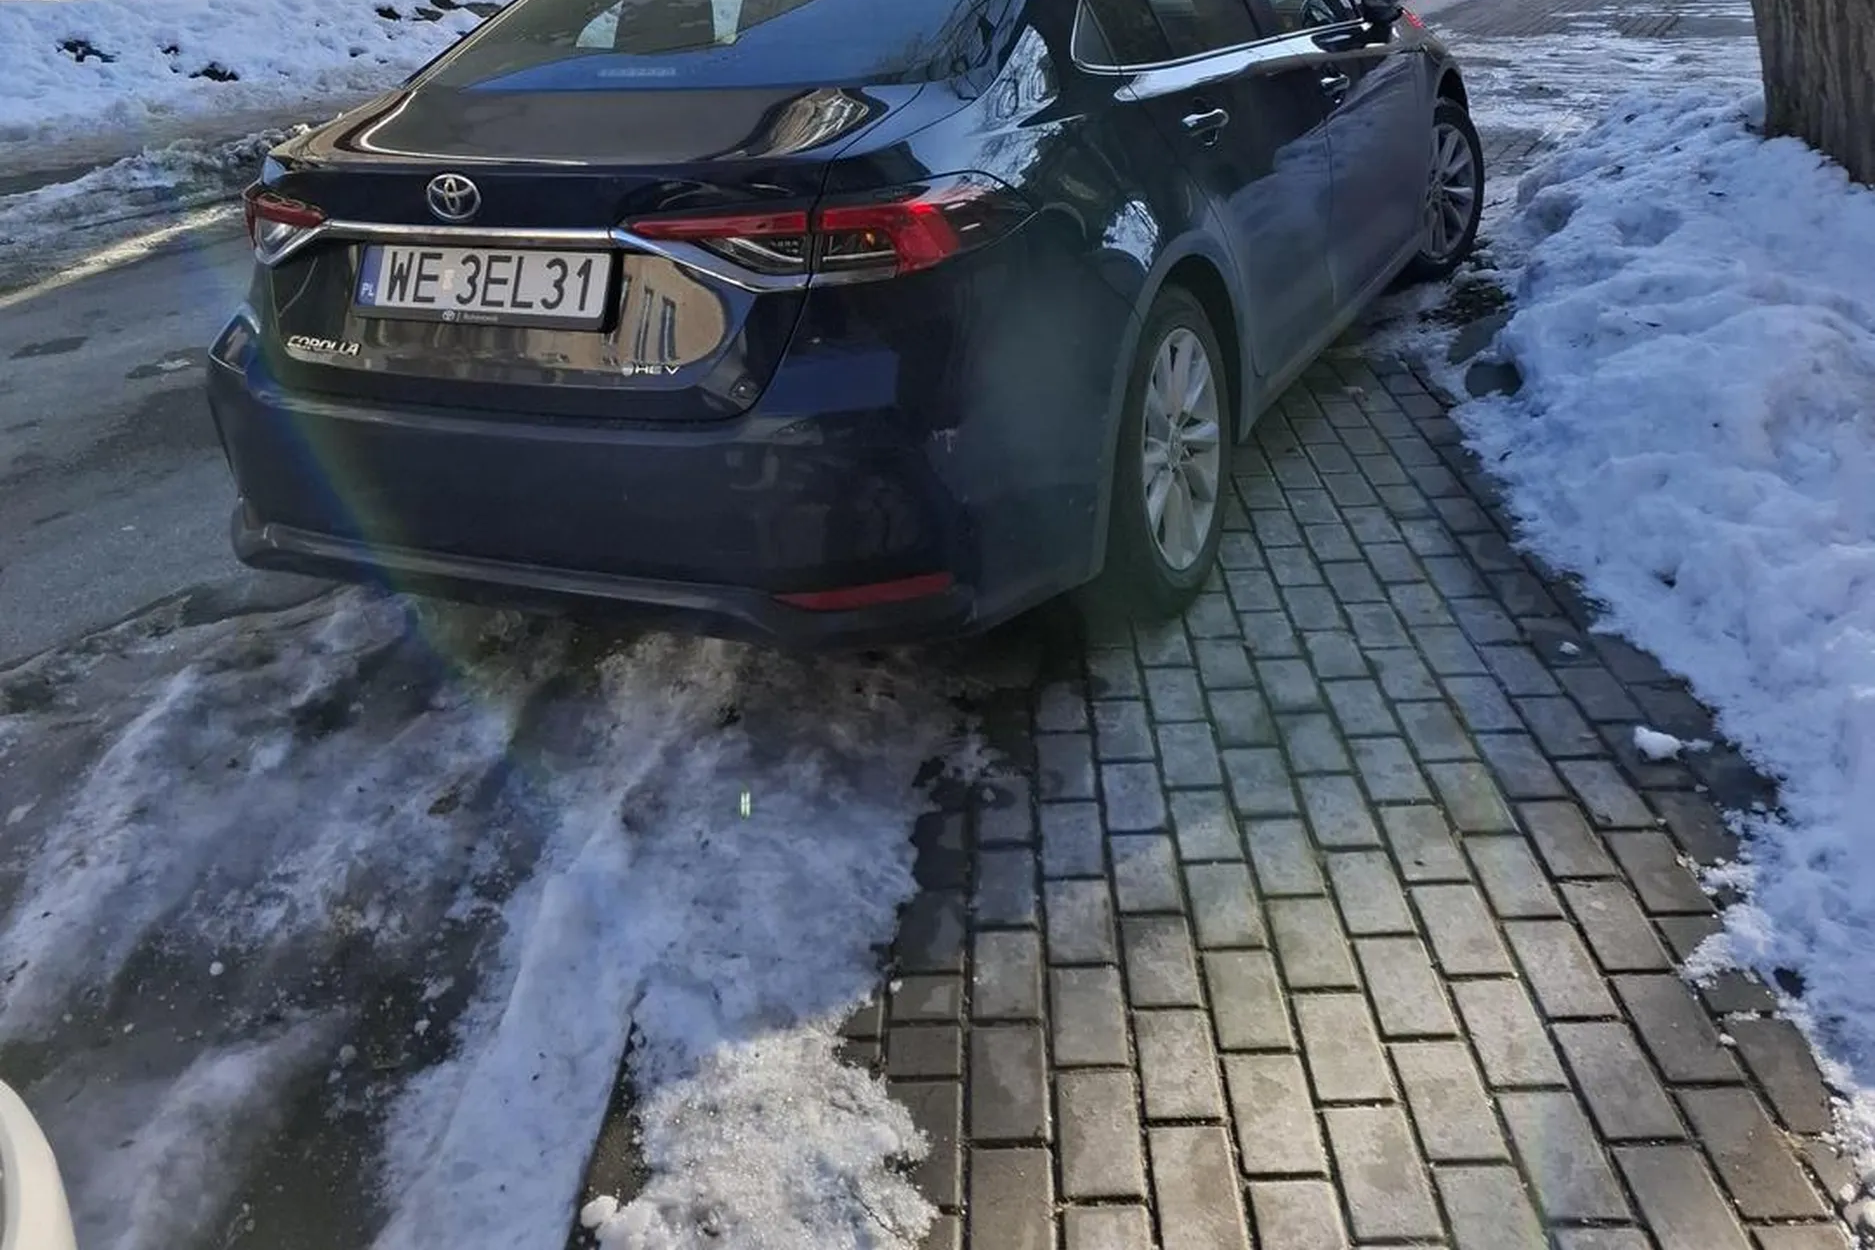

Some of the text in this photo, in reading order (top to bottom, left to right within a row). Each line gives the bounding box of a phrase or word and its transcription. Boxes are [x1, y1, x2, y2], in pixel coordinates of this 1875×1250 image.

[386, 251, 593, 312] WE 3EL31
[286, 334, 362, 357] COROLLA
